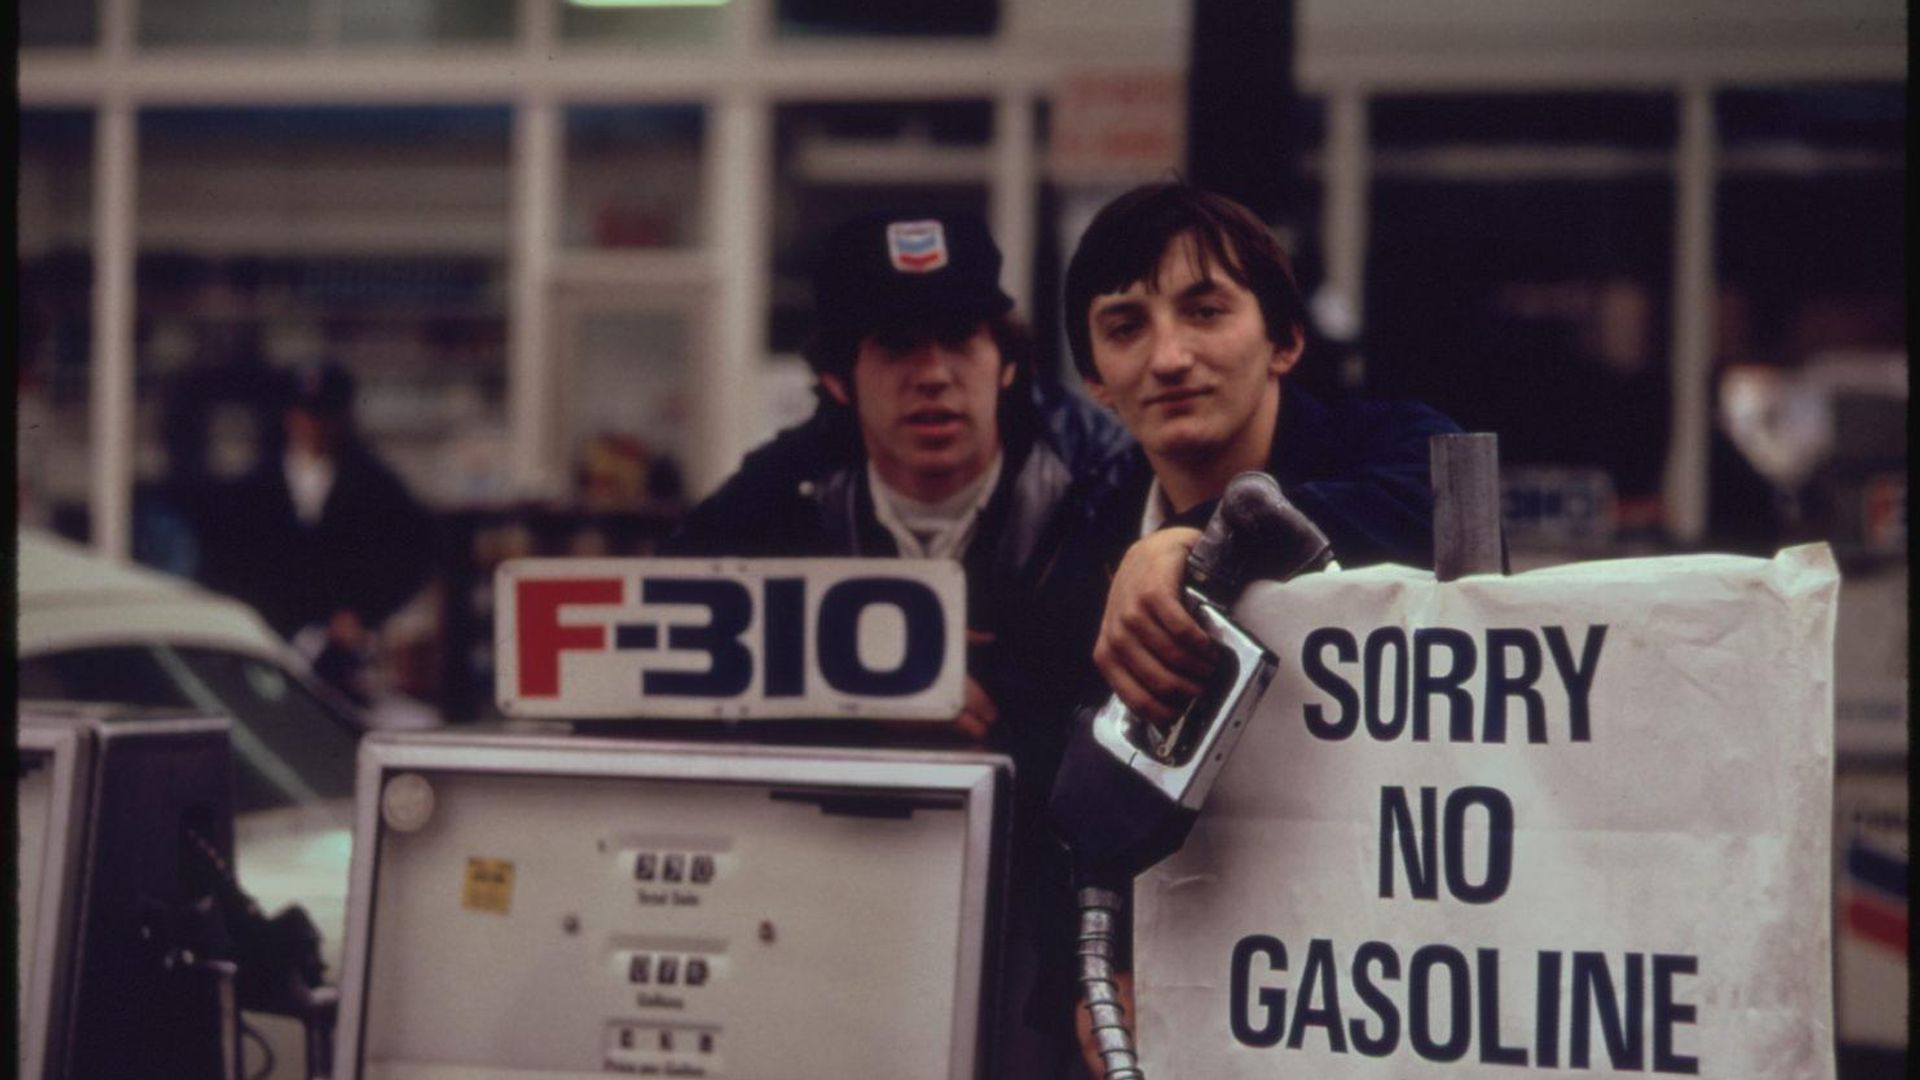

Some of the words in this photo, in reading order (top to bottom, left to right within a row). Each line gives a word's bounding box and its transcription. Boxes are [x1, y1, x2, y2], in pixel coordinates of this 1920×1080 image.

[516, 577, 946, 698] F-310
[1302, 624, 1609, 744] SORRY
[1378, 785, 1514, 904] NO
[1229, 934, 1699, 1075] GASOLINE
